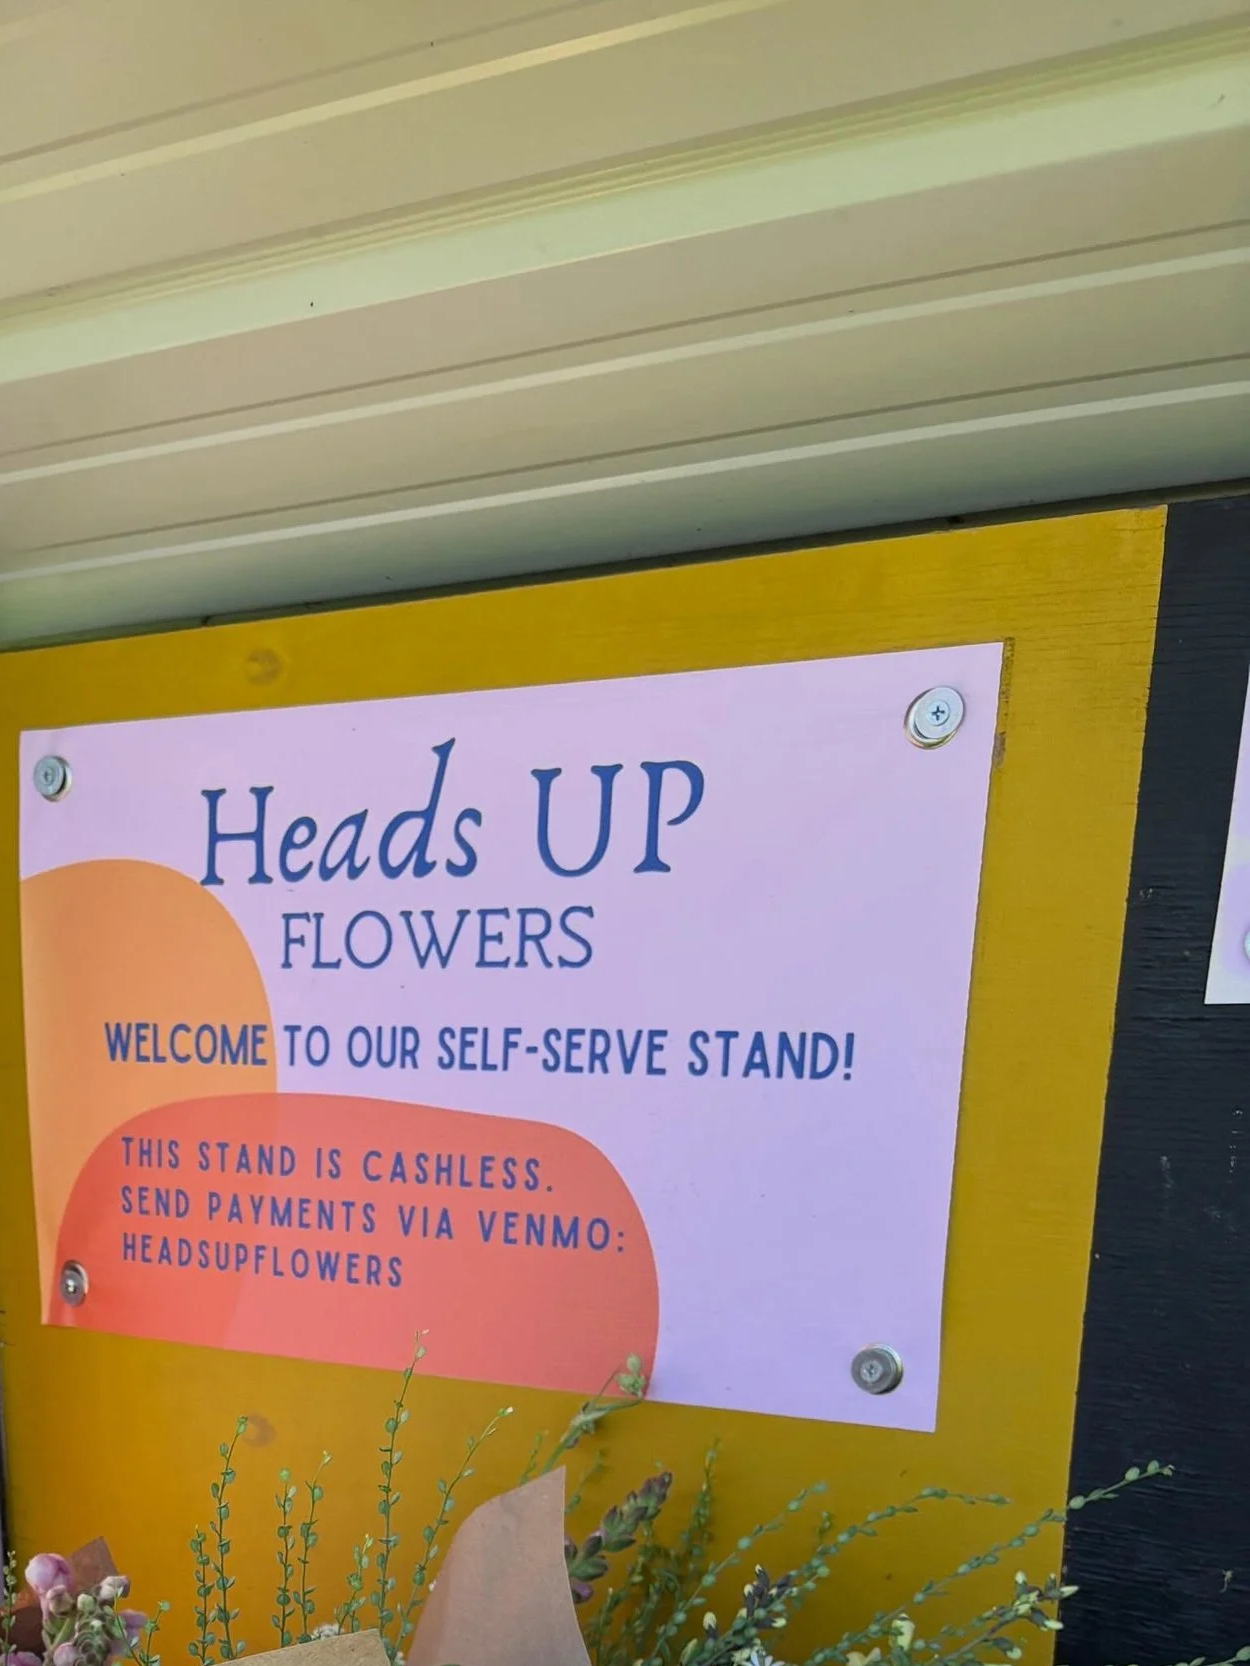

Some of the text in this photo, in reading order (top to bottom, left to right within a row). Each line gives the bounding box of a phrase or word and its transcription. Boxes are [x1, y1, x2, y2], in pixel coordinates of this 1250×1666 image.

[198, 736, 708, 888] Heads UP
[278, 904, 597, 970] FLOWERS
[103, 1020, 858, 1082] WELCOME TO OUR SELF-SERVE STAND!
[120, 1136, 556, 1193] THIS STAND IS CASHLESS.
[120, 1186, 628, 1253] SEND PAYMENTS VIA VENMO:
[122, 1233, 403, 1287] HEADSUPFLOWERS
